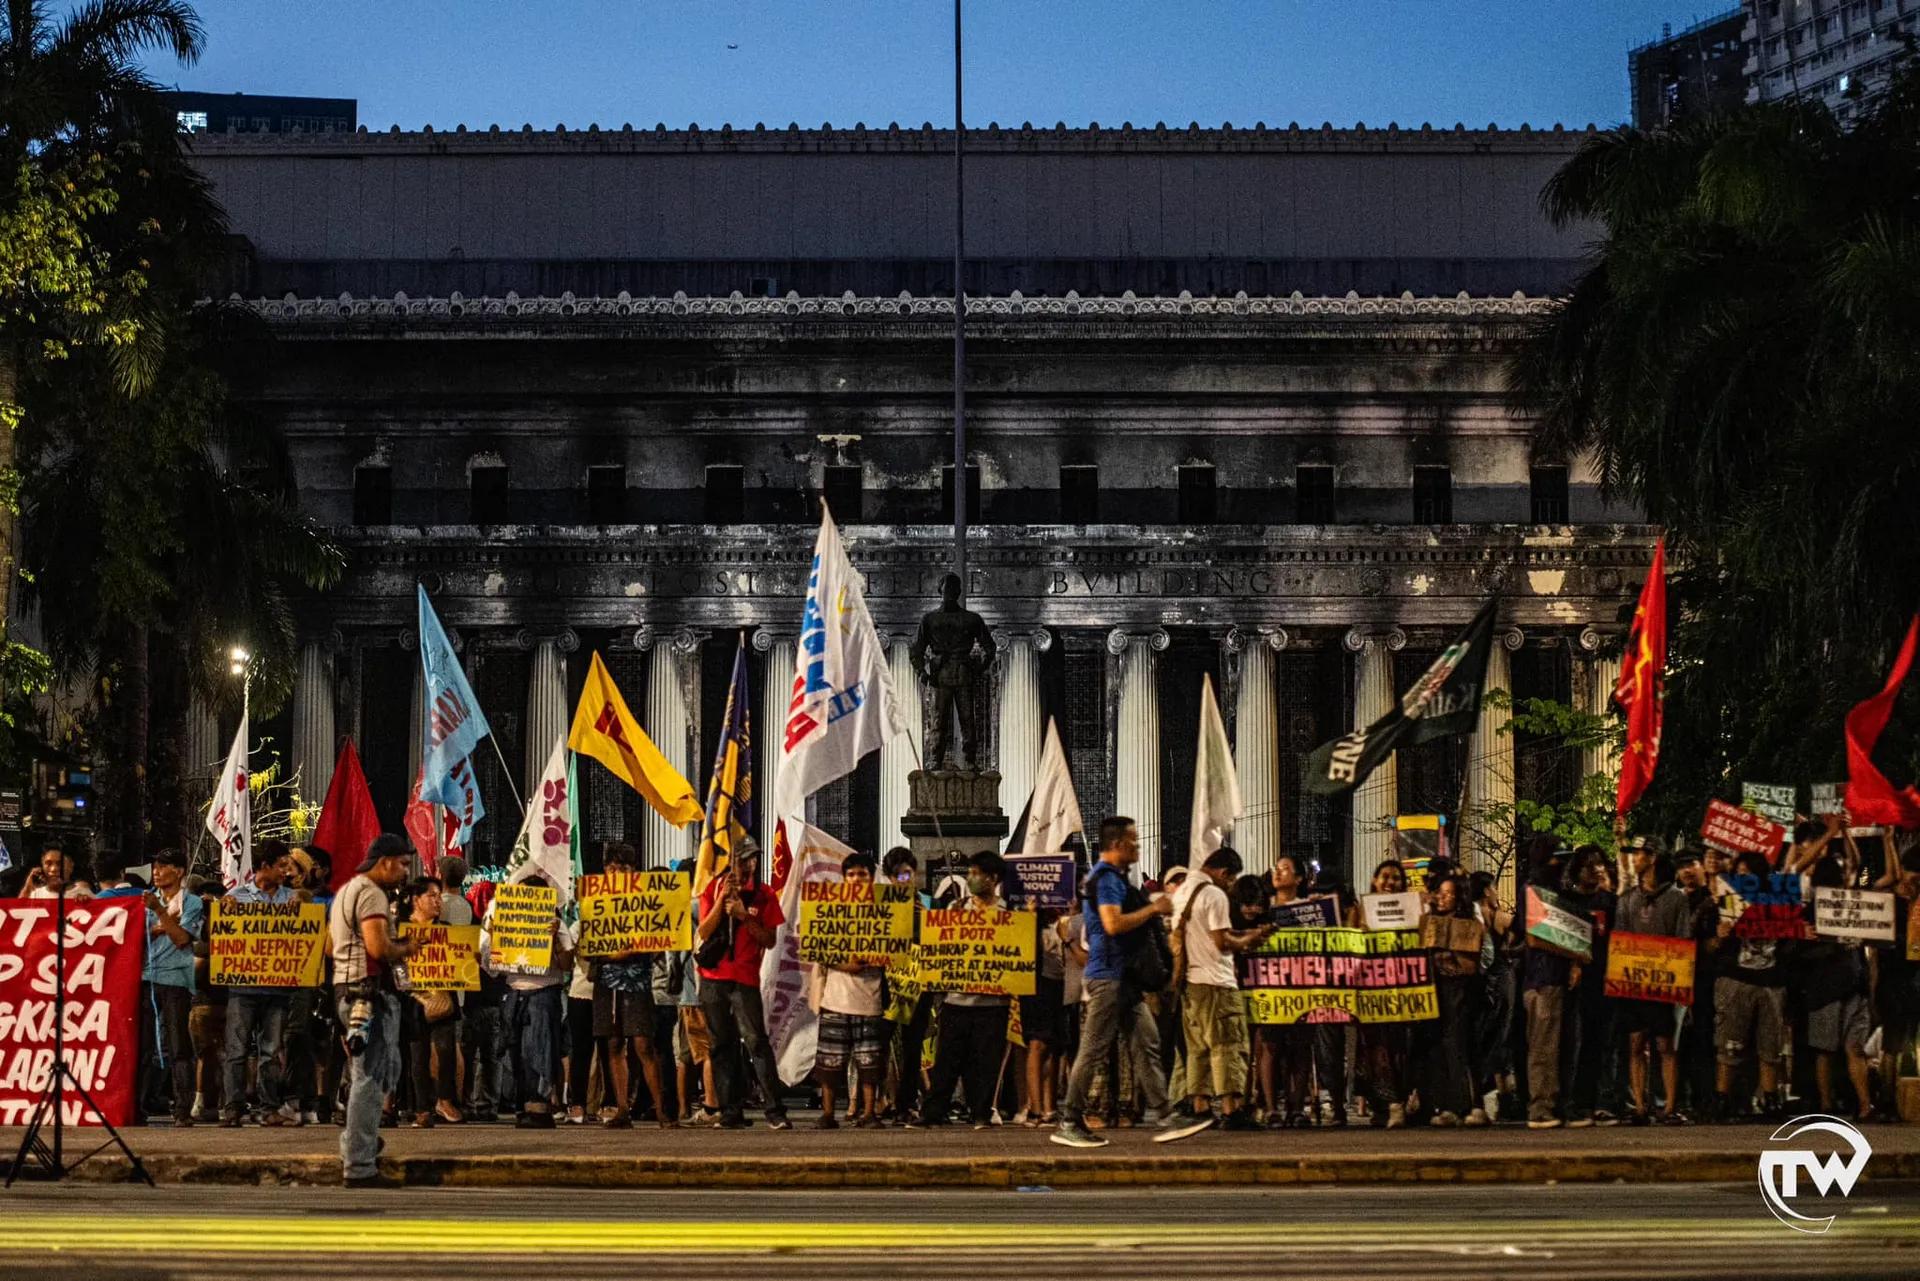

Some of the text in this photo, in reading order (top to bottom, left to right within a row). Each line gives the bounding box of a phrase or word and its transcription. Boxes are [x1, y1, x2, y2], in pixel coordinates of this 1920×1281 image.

[1051, 571, 1271, 594] BVILDING
[1015, 863, 1062, 873] CLIMATE
[581, 870, 680, 897] IBALIK ANG
[1018, 872, 1060, 882] JUSTICE
[802, 880, 911, 903] IBASURA ANG
[1023, 882, 1055, 891] NOW!
[219, 902, 301, 918] KABUHAYAN
[593, 895, 664, 917] 5 TAONG
[816, 904, 894, 919] SAPILITANG
[926, 909, 1014, 928] MARCOS JR.
[48, 906, 128, 949] SA
[211, 920, 320, 935] ANG KAILANGAN
[809, 920, 892, 935] FRANCHISE
[939, 928, 996, 941] AT DOTR
[211, 939, 316, 956] HINDI JEEPNEY
[801, 935, 913, 956] CONSOLIDATION!
[921, 943, 969, 957] PAHIRAP
[973, 944, 987, 957] SA
[992, 944, 1021, 957] MGA
[30, 952, 105, 995] SA
[222, 957, 309, 974] PHASE OUT!
[921, 959, 965, 971] TSUPER
[968, 959, 981, 971] AT
[1243, 956, 1326, 985] JEEPNEY
[1274, 994, 1305, 1016] PRO
[1308, 993, 1353, 1012] PEOPLE
[1357, 991, 1434, 1015] TRANSPORT
